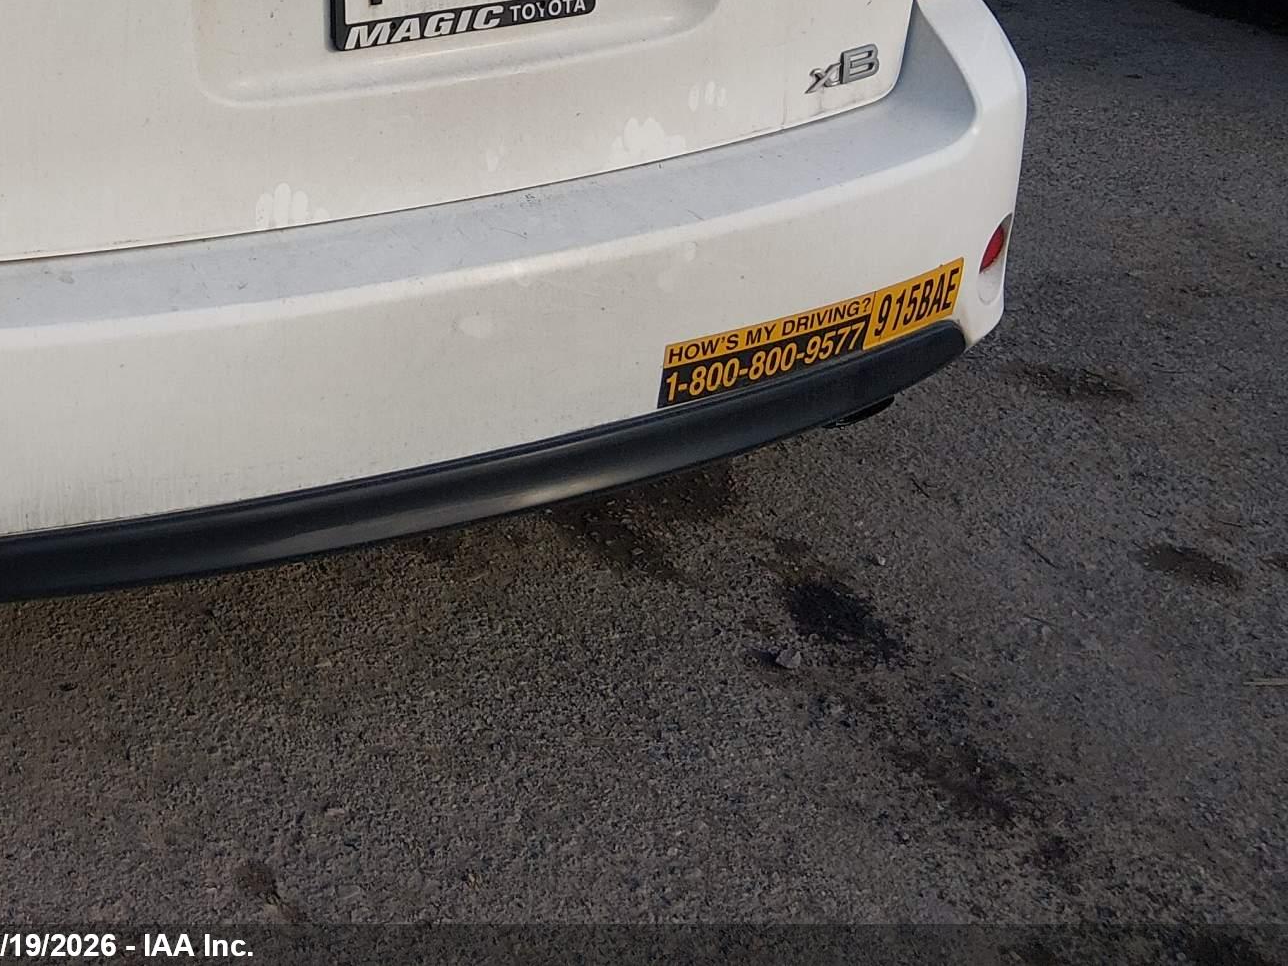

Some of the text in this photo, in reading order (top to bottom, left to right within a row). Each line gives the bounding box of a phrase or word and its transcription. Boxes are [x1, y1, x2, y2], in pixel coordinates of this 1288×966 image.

[344, 4, 505, 51] MAGIC
[804, 43, 880, 94] xB
[668, 297, 871, 364] HOW'S MY DRIVING?
[873, 267, 960, 337] 915BAE
[665, 320, 868, 403] 1-800-800-9577
